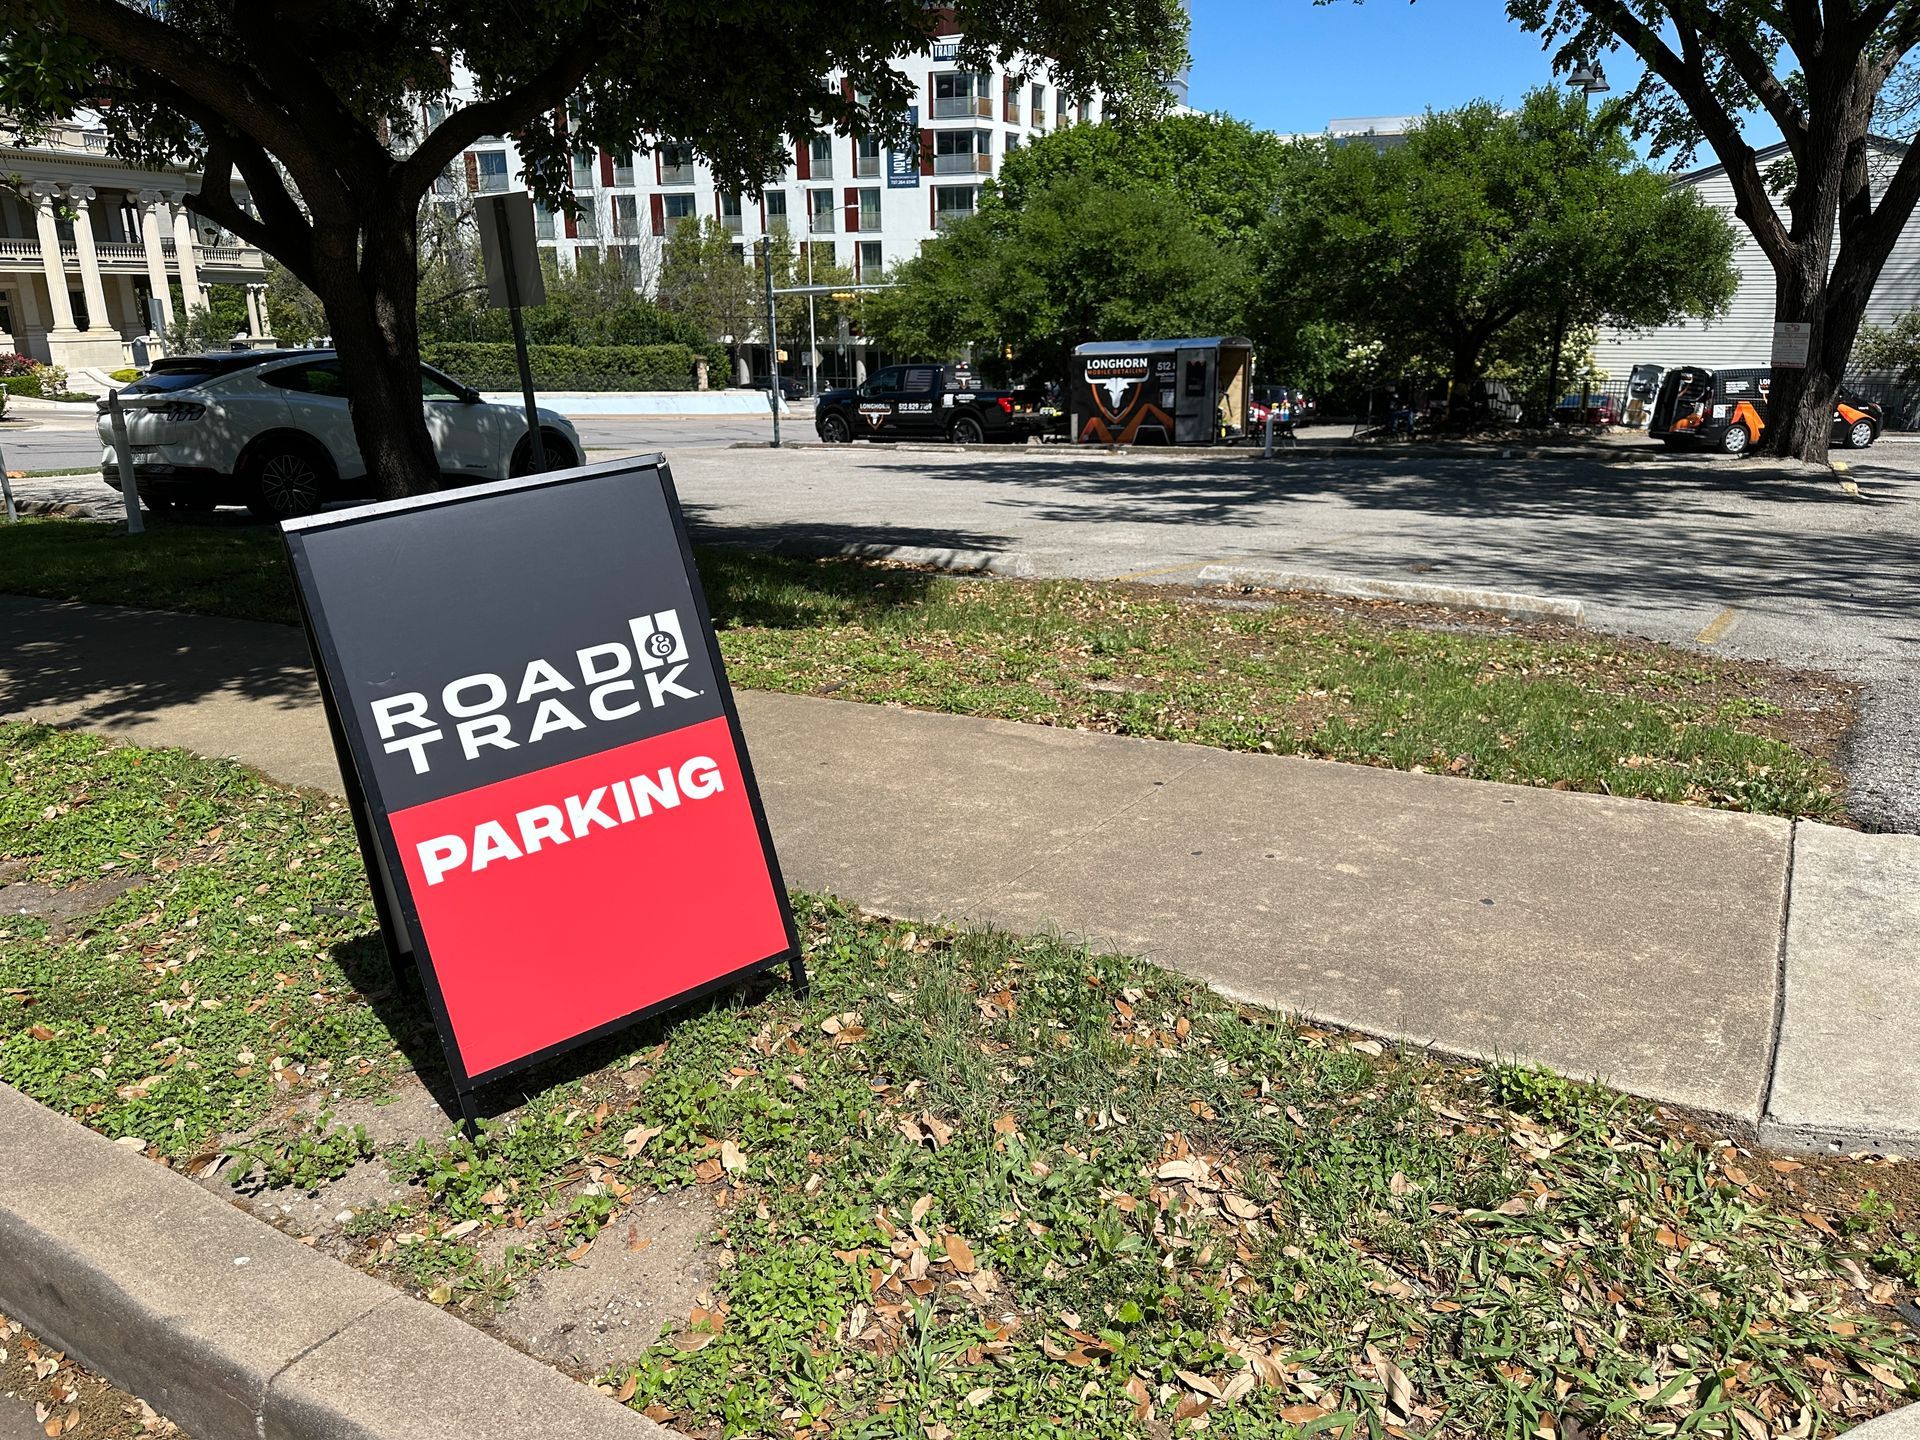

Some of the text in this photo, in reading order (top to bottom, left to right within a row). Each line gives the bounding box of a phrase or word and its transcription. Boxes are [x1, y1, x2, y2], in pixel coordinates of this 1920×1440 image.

[1087, 358, 1148, 369] LONGHORN
[1112, 367, 1148, 375] DETAILING
[371, 642, 632, 739] ROAD
[416, 756, 725, 886] PARKING
